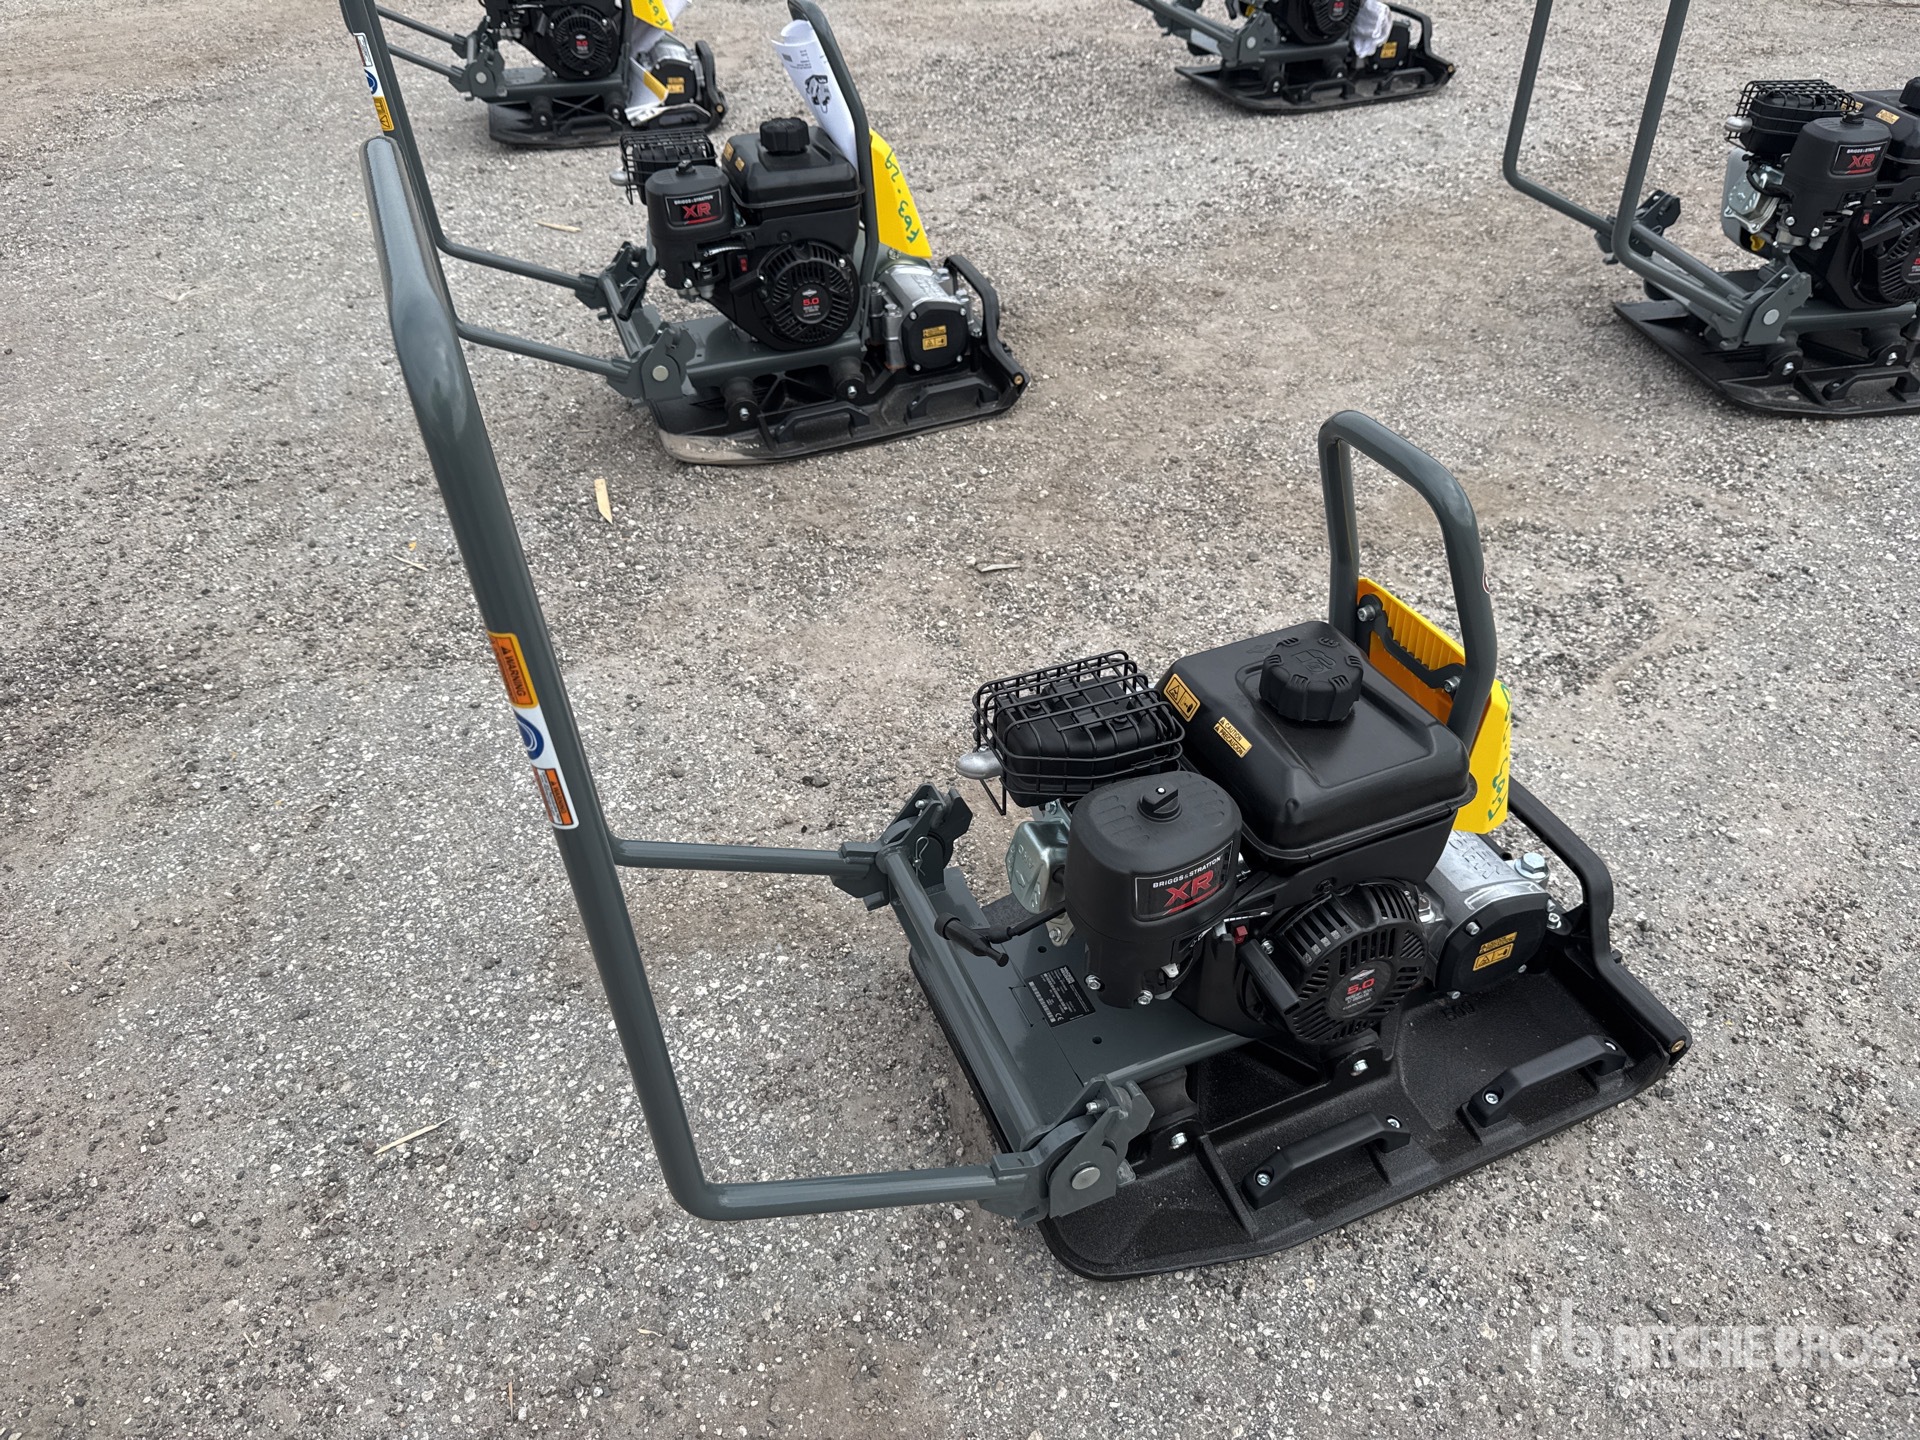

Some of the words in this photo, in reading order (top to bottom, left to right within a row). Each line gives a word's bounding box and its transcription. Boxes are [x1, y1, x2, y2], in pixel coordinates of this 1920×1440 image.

[1848, 153, 1875, 168] XR
[682, 202, 711, 219] XR
[505, 656, 526, 697] WARNING
[1224, 722, 1242, 741] CAUTION
[1164, 870, 1214, 907] XR
[1346, 978, 1375, 996] 5.0
